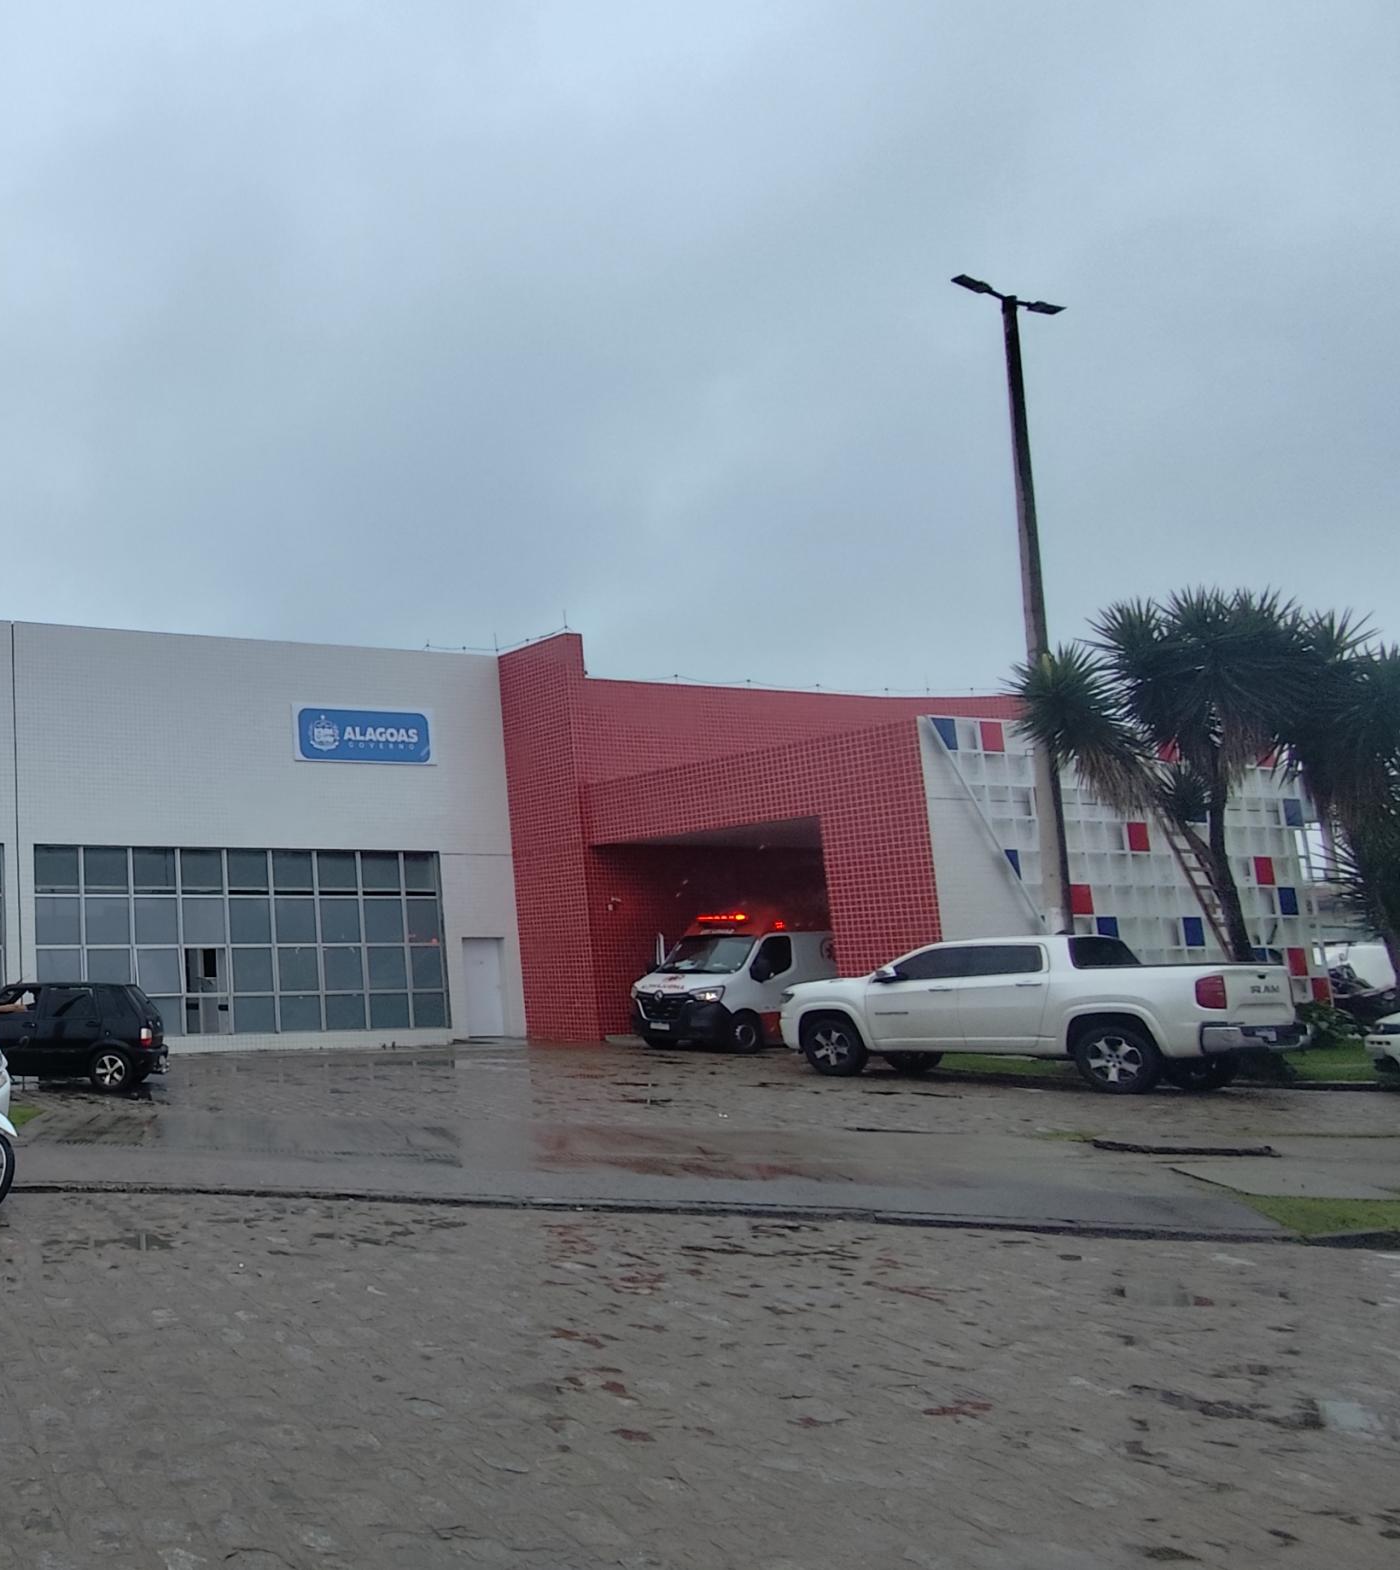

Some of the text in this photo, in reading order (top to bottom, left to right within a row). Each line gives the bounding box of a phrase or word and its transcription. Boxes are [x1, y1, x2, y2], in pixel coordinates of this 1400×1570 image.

[343, 726, 418, 743] ALAGOAS
[348, 742, 415, 750] GOVERNO
[1250, 985, 1280, 993] RAM
